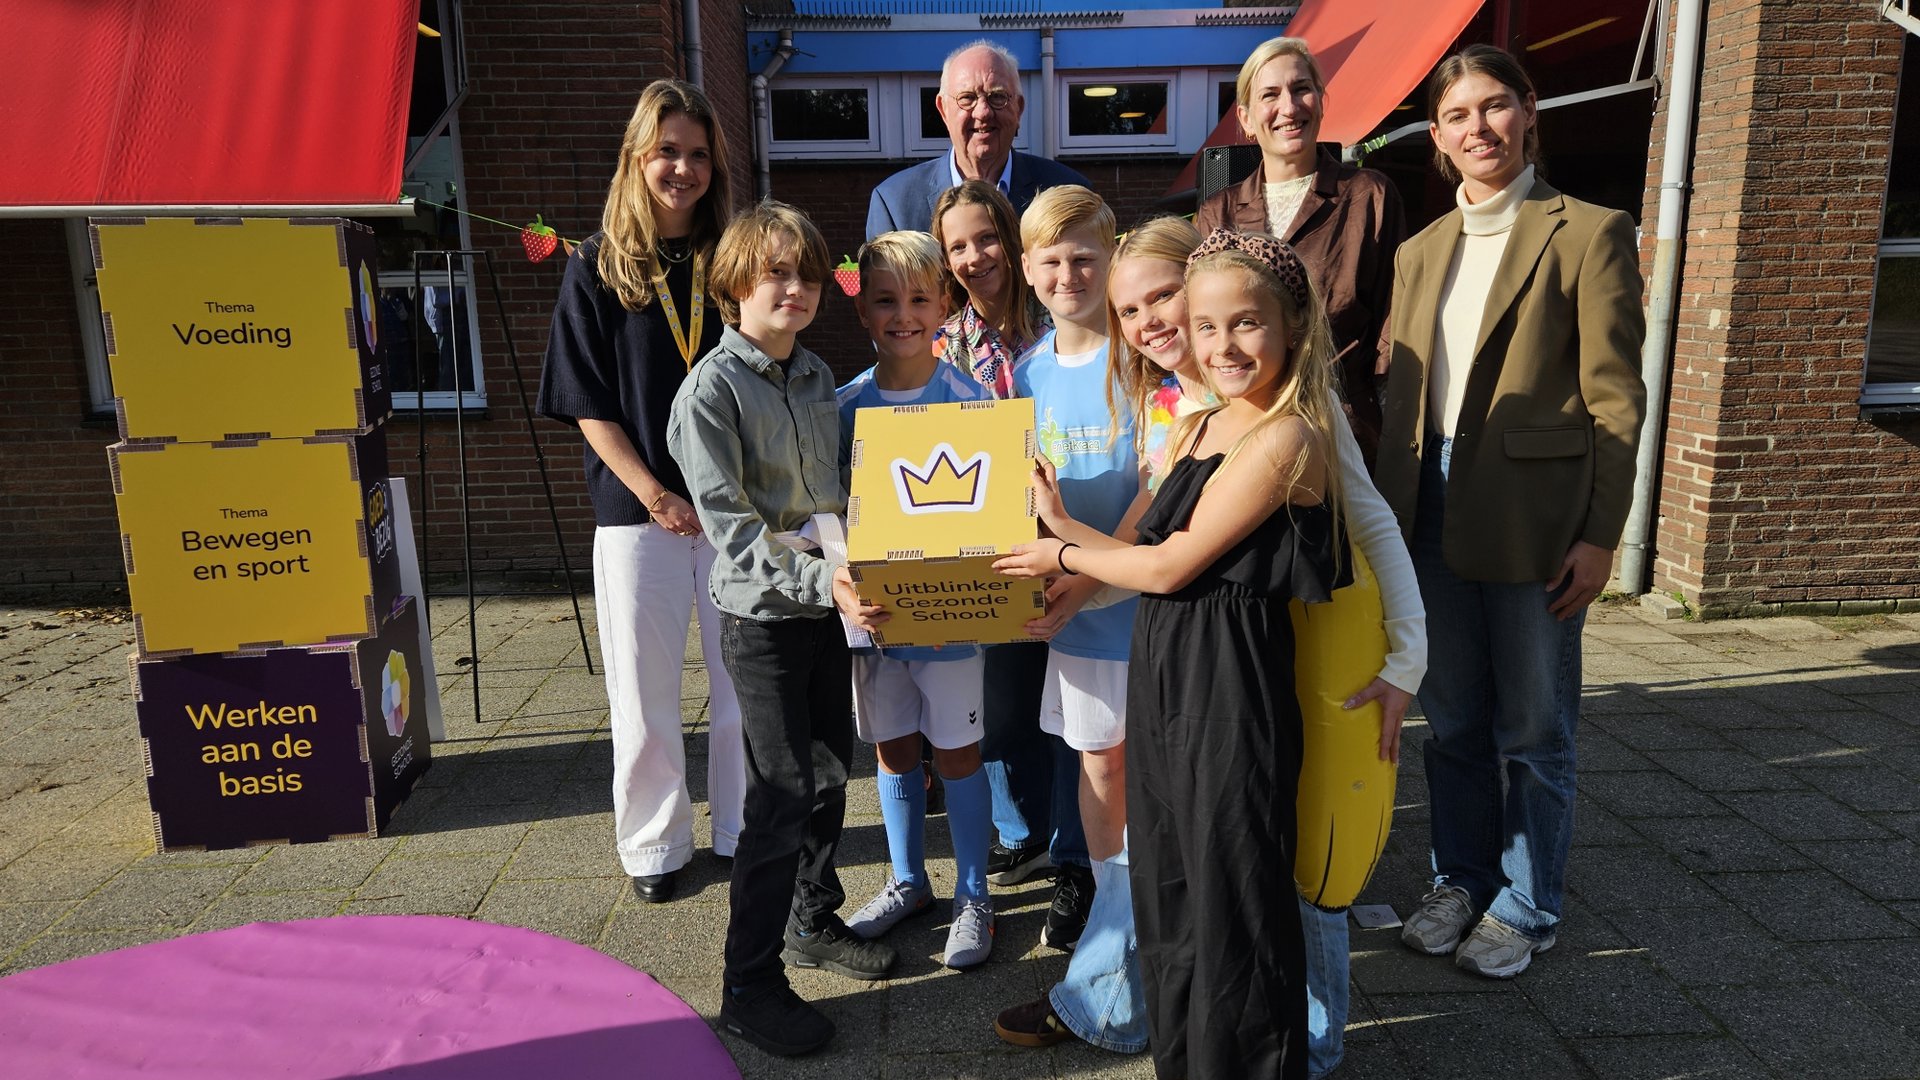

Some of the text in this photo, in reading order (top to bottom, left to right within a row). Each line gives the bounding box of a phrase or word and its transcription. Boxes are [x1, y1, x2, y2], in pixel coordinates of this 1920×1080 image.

[204, 301, 255, 314] Thema
[172, 322, 292, 349] Voeding
[219, 508, 269, 520] Thema
[181, 528, 312, 552] Bewegen
[193, 554, 310, 582] en sport
[883, 579, 1014, 596] Uitblinker
[895, 593, 1009, 609] Gezonde
[911, 607, 1000, 622] School
[184, 700, 318, 730] Werken
[201, 733, 313, 764] aan de
[391, 735, 413, 768] GEZONDE
[393, 751, 414, 780] SCHOOL
[219, 767, 303, 797] basis
